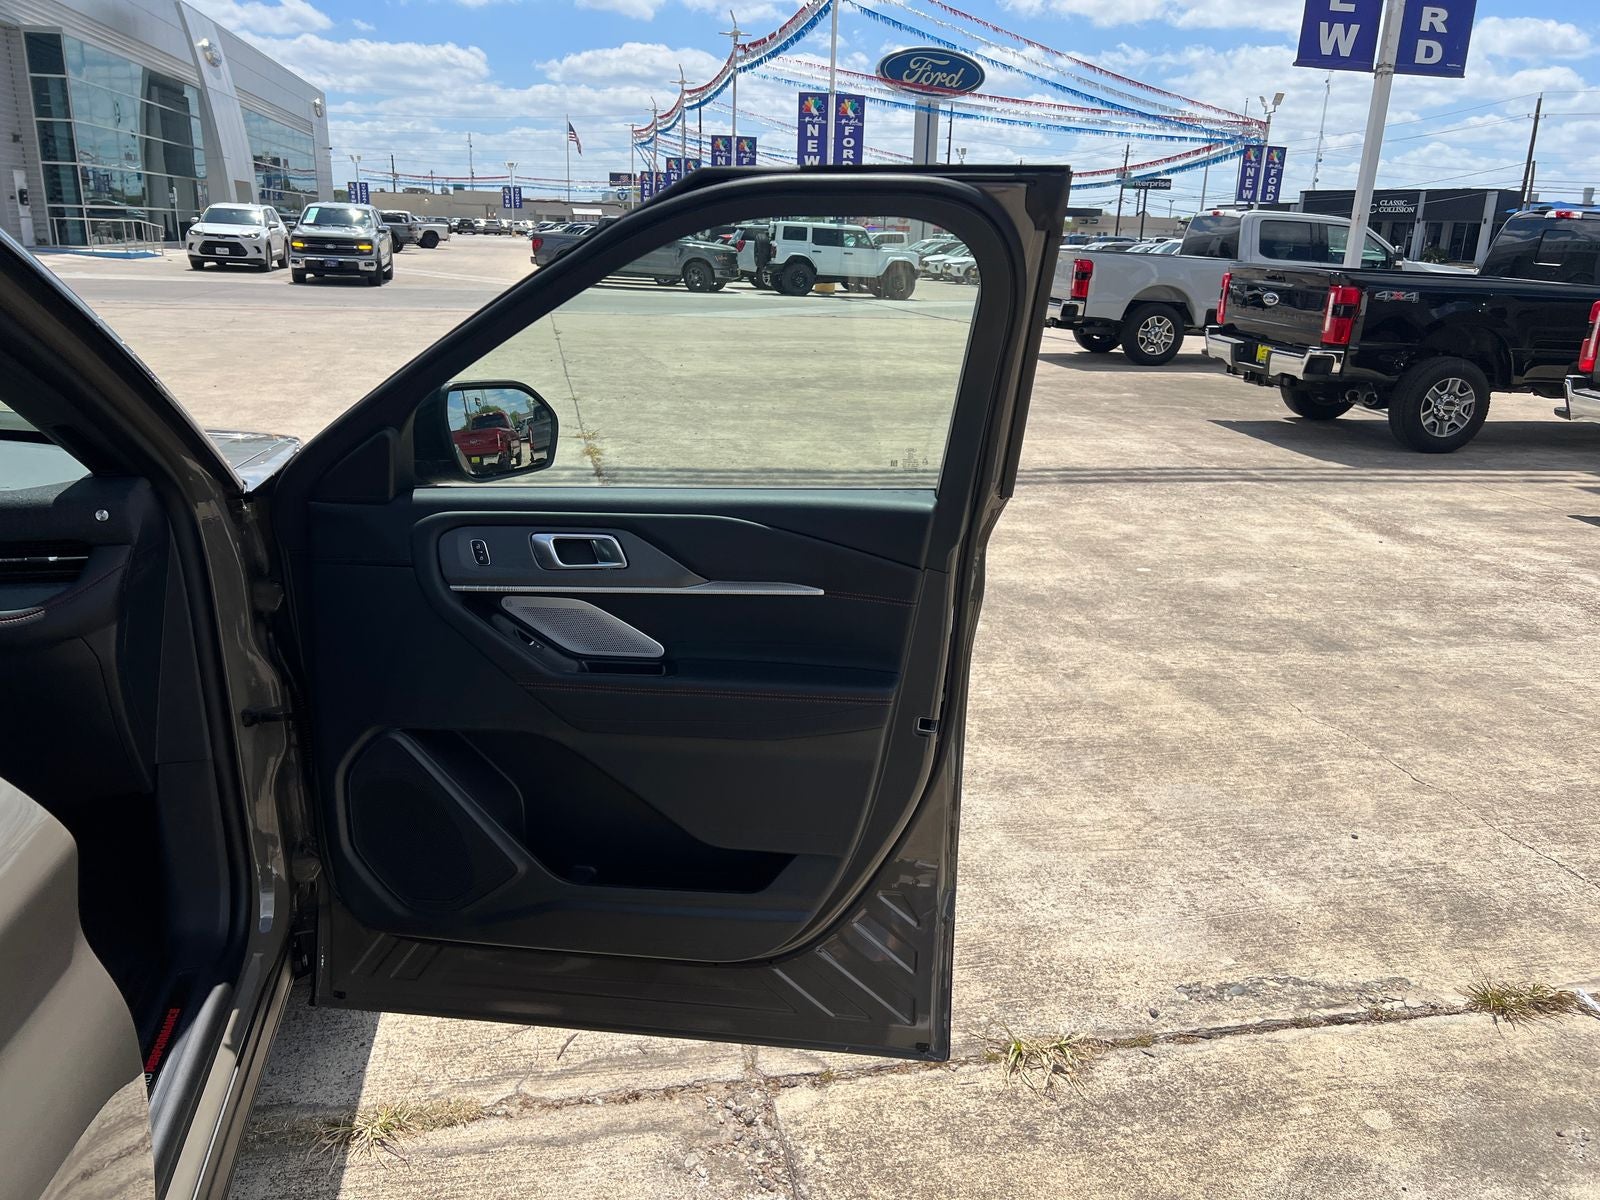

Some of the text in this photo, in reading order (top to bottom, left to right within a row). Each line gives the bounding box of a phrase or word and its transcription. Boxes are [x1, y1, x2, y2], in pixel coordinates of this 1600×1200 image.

[903, 56, 965, 88] Ford
[804, 124, 820, 166] NEW
[1132, 179, 1171, 189] nterprise
[1242, 167, 1255, 199] NEW
[1266, 168, 1278, 201] FORD
[1379, 199, 1408, 207] CLASSIC
